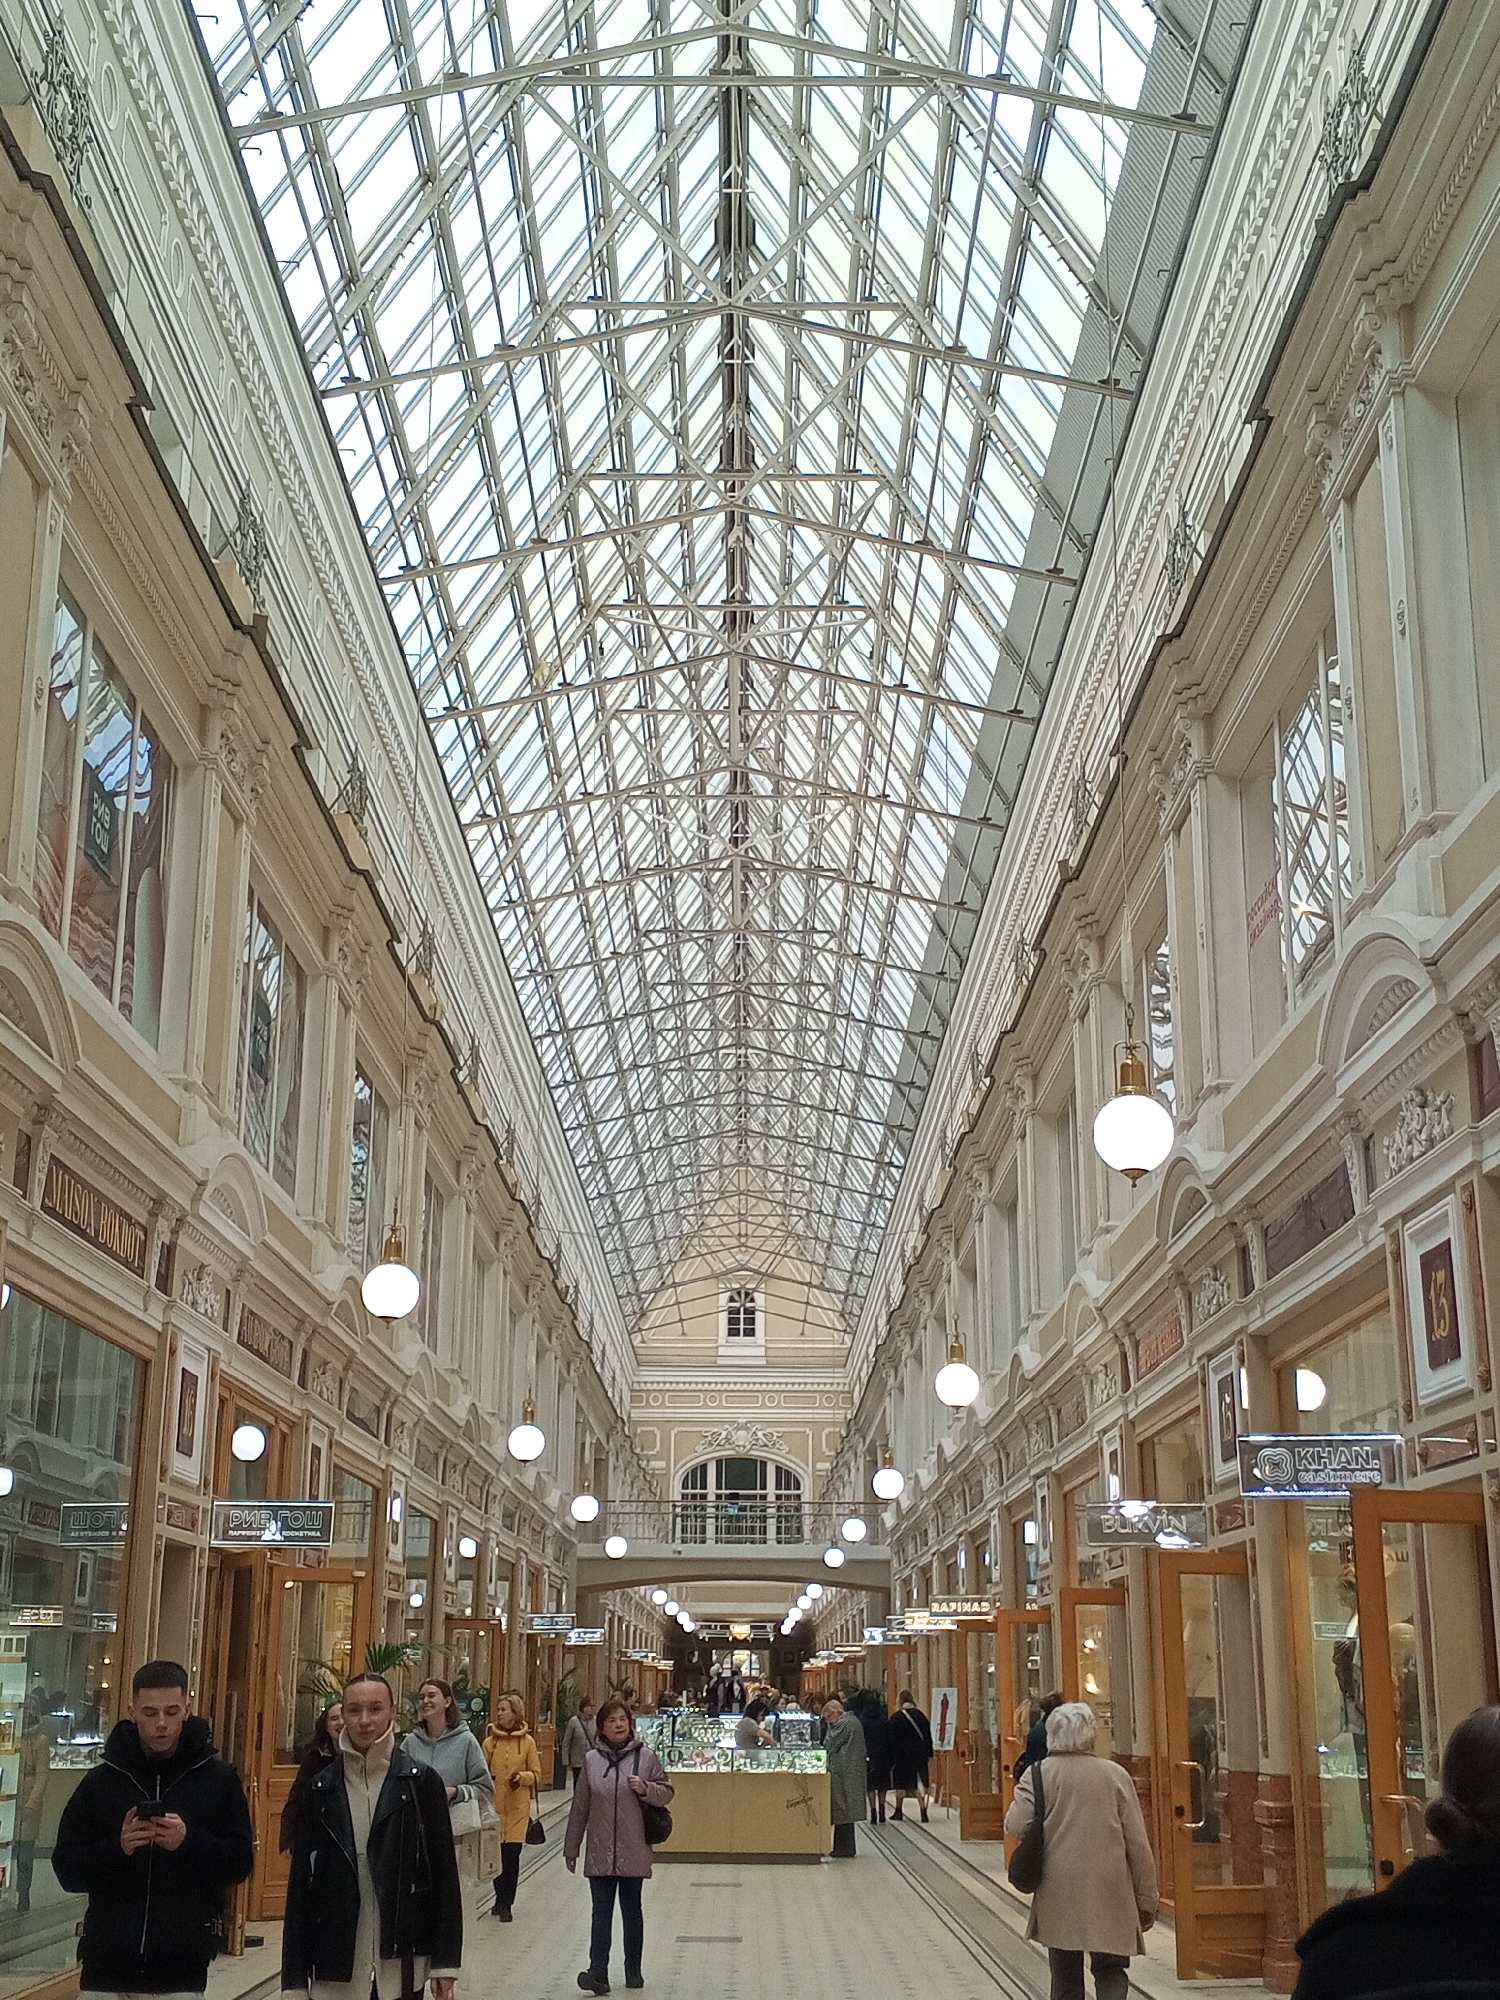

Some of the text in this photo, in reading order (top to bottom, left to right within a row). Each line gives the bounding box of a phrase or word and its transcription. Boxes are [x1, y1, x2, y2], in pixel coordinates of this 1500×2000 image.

[93, 790, 111, 829] РИВ
[91, 815, 109, 854] ГОШ
[45, 1165, 98, 1238] MAISON
[1428, 1269, 1450, 1341] 13
[1297, 1468, 1381, 1483] cashmere
[229, 1510, 323, 1529] РИВ ГОШ
[930, 1601, 991, 1613] RAFINAD
